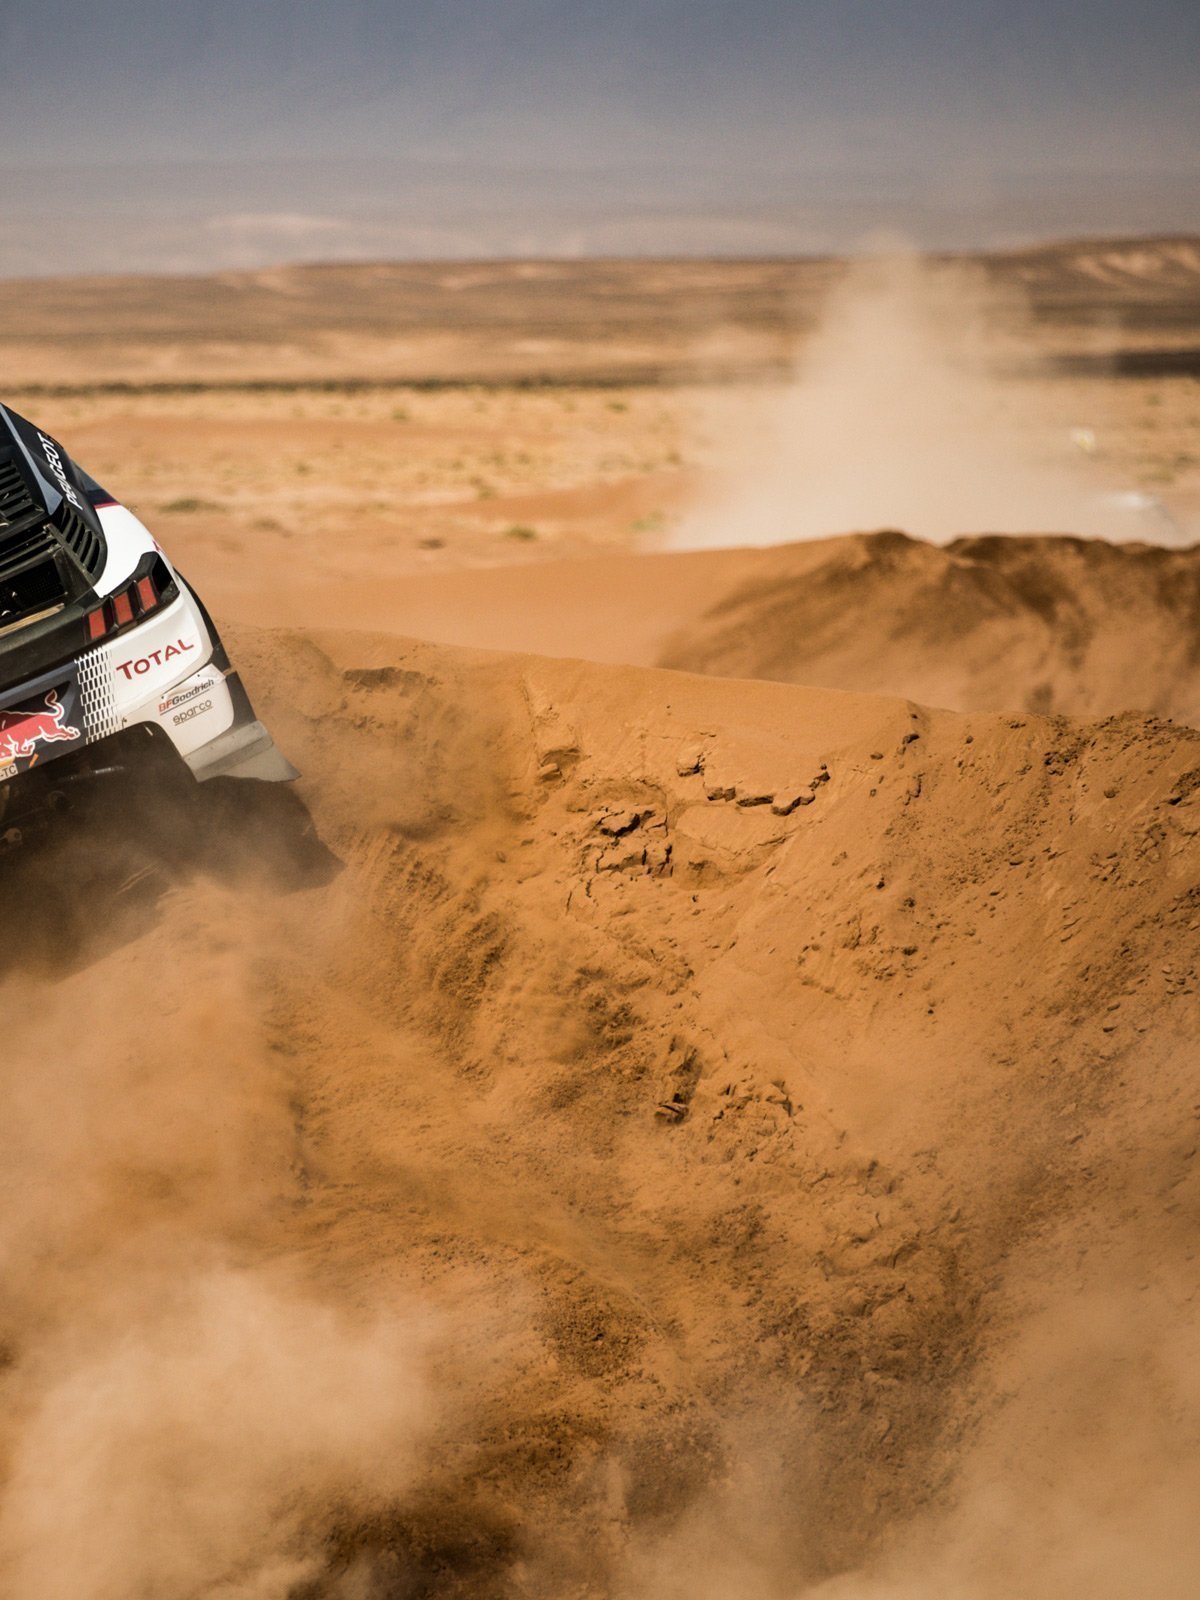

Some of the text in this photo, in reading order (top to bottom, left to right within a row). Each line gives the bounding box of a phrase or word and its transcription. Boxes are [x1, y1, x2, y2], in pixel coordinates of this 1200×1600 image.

[37, 432, 83, 510] PEUGEOT
[116, 639, 194, 680] TOTAL
[158, 679, 214, 714] BFGoodrich
[172, 699, 213, 725] sparco
